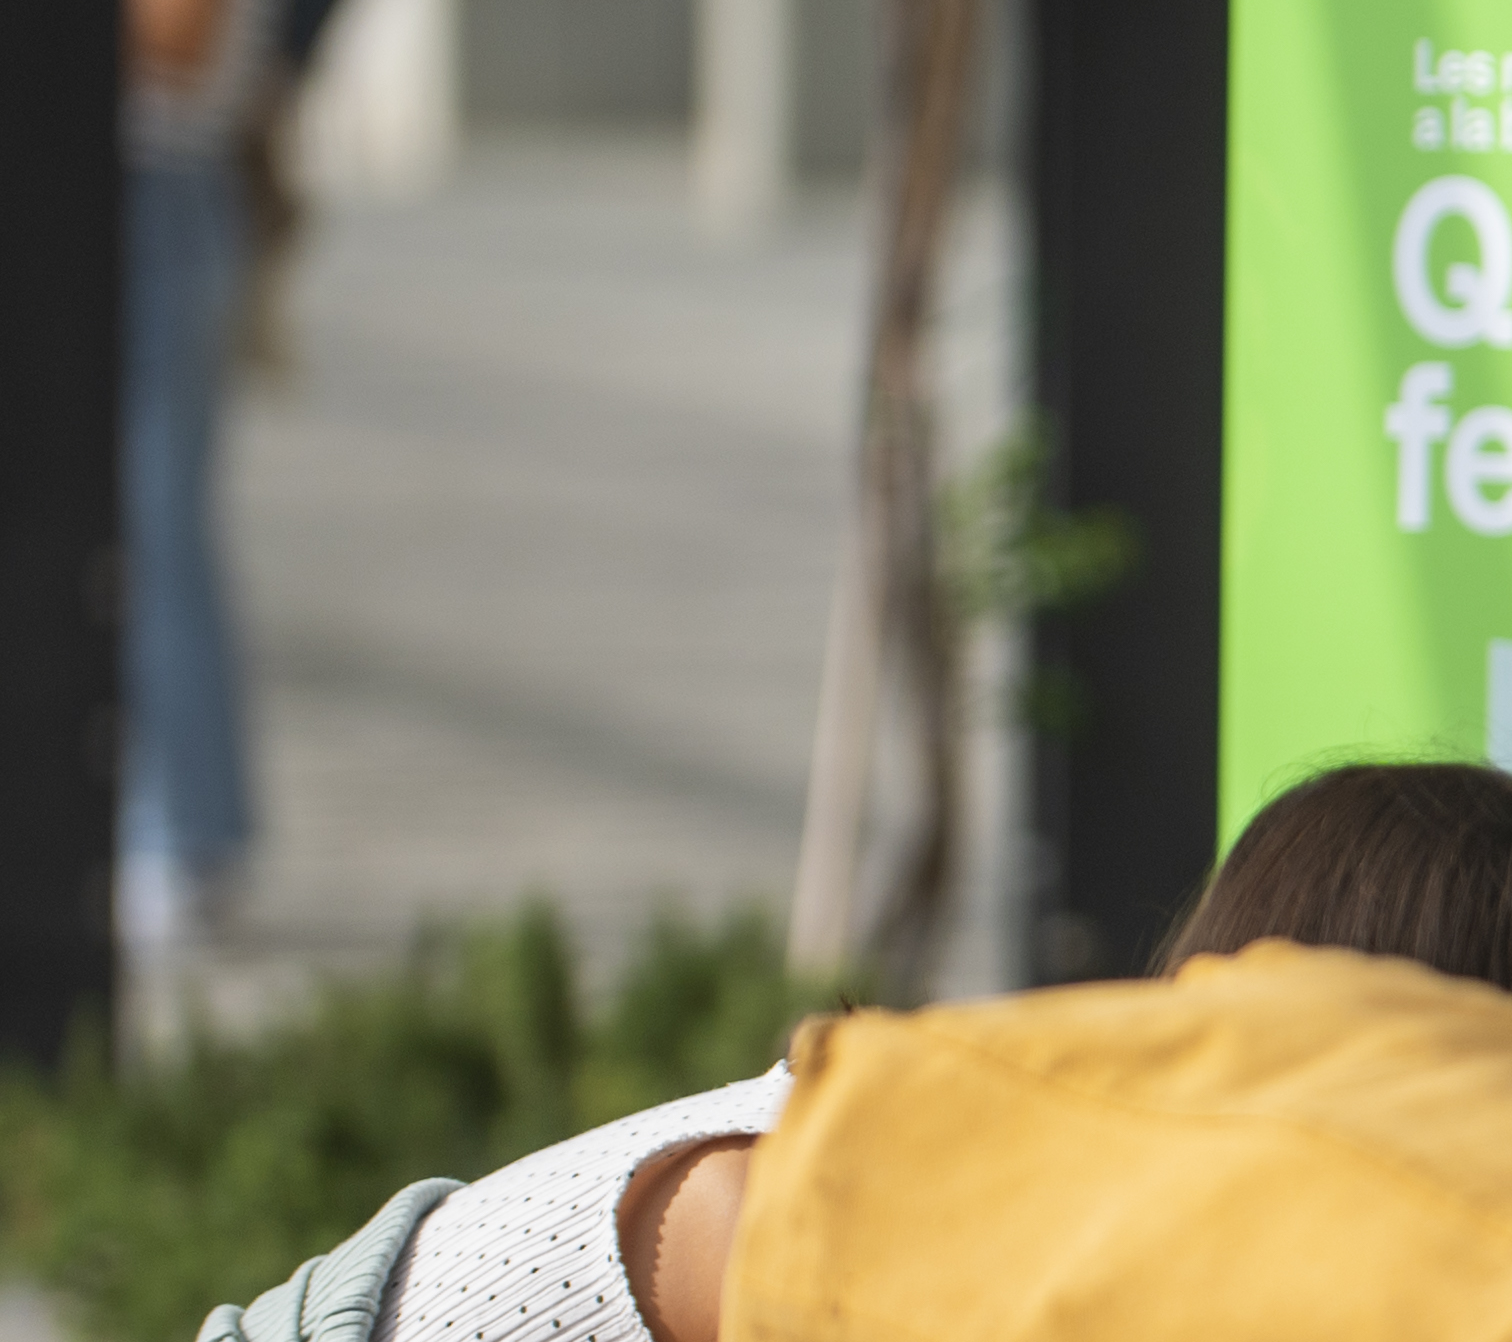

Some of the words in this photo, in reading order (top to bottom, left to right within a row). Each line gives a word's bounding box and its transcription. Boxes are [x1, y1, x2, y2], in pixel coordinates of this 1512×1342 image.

[1412, 37, 1497, 96] Les
[1411, 105, 1446, 152] a
[1449, 96, 1496, 153] la
